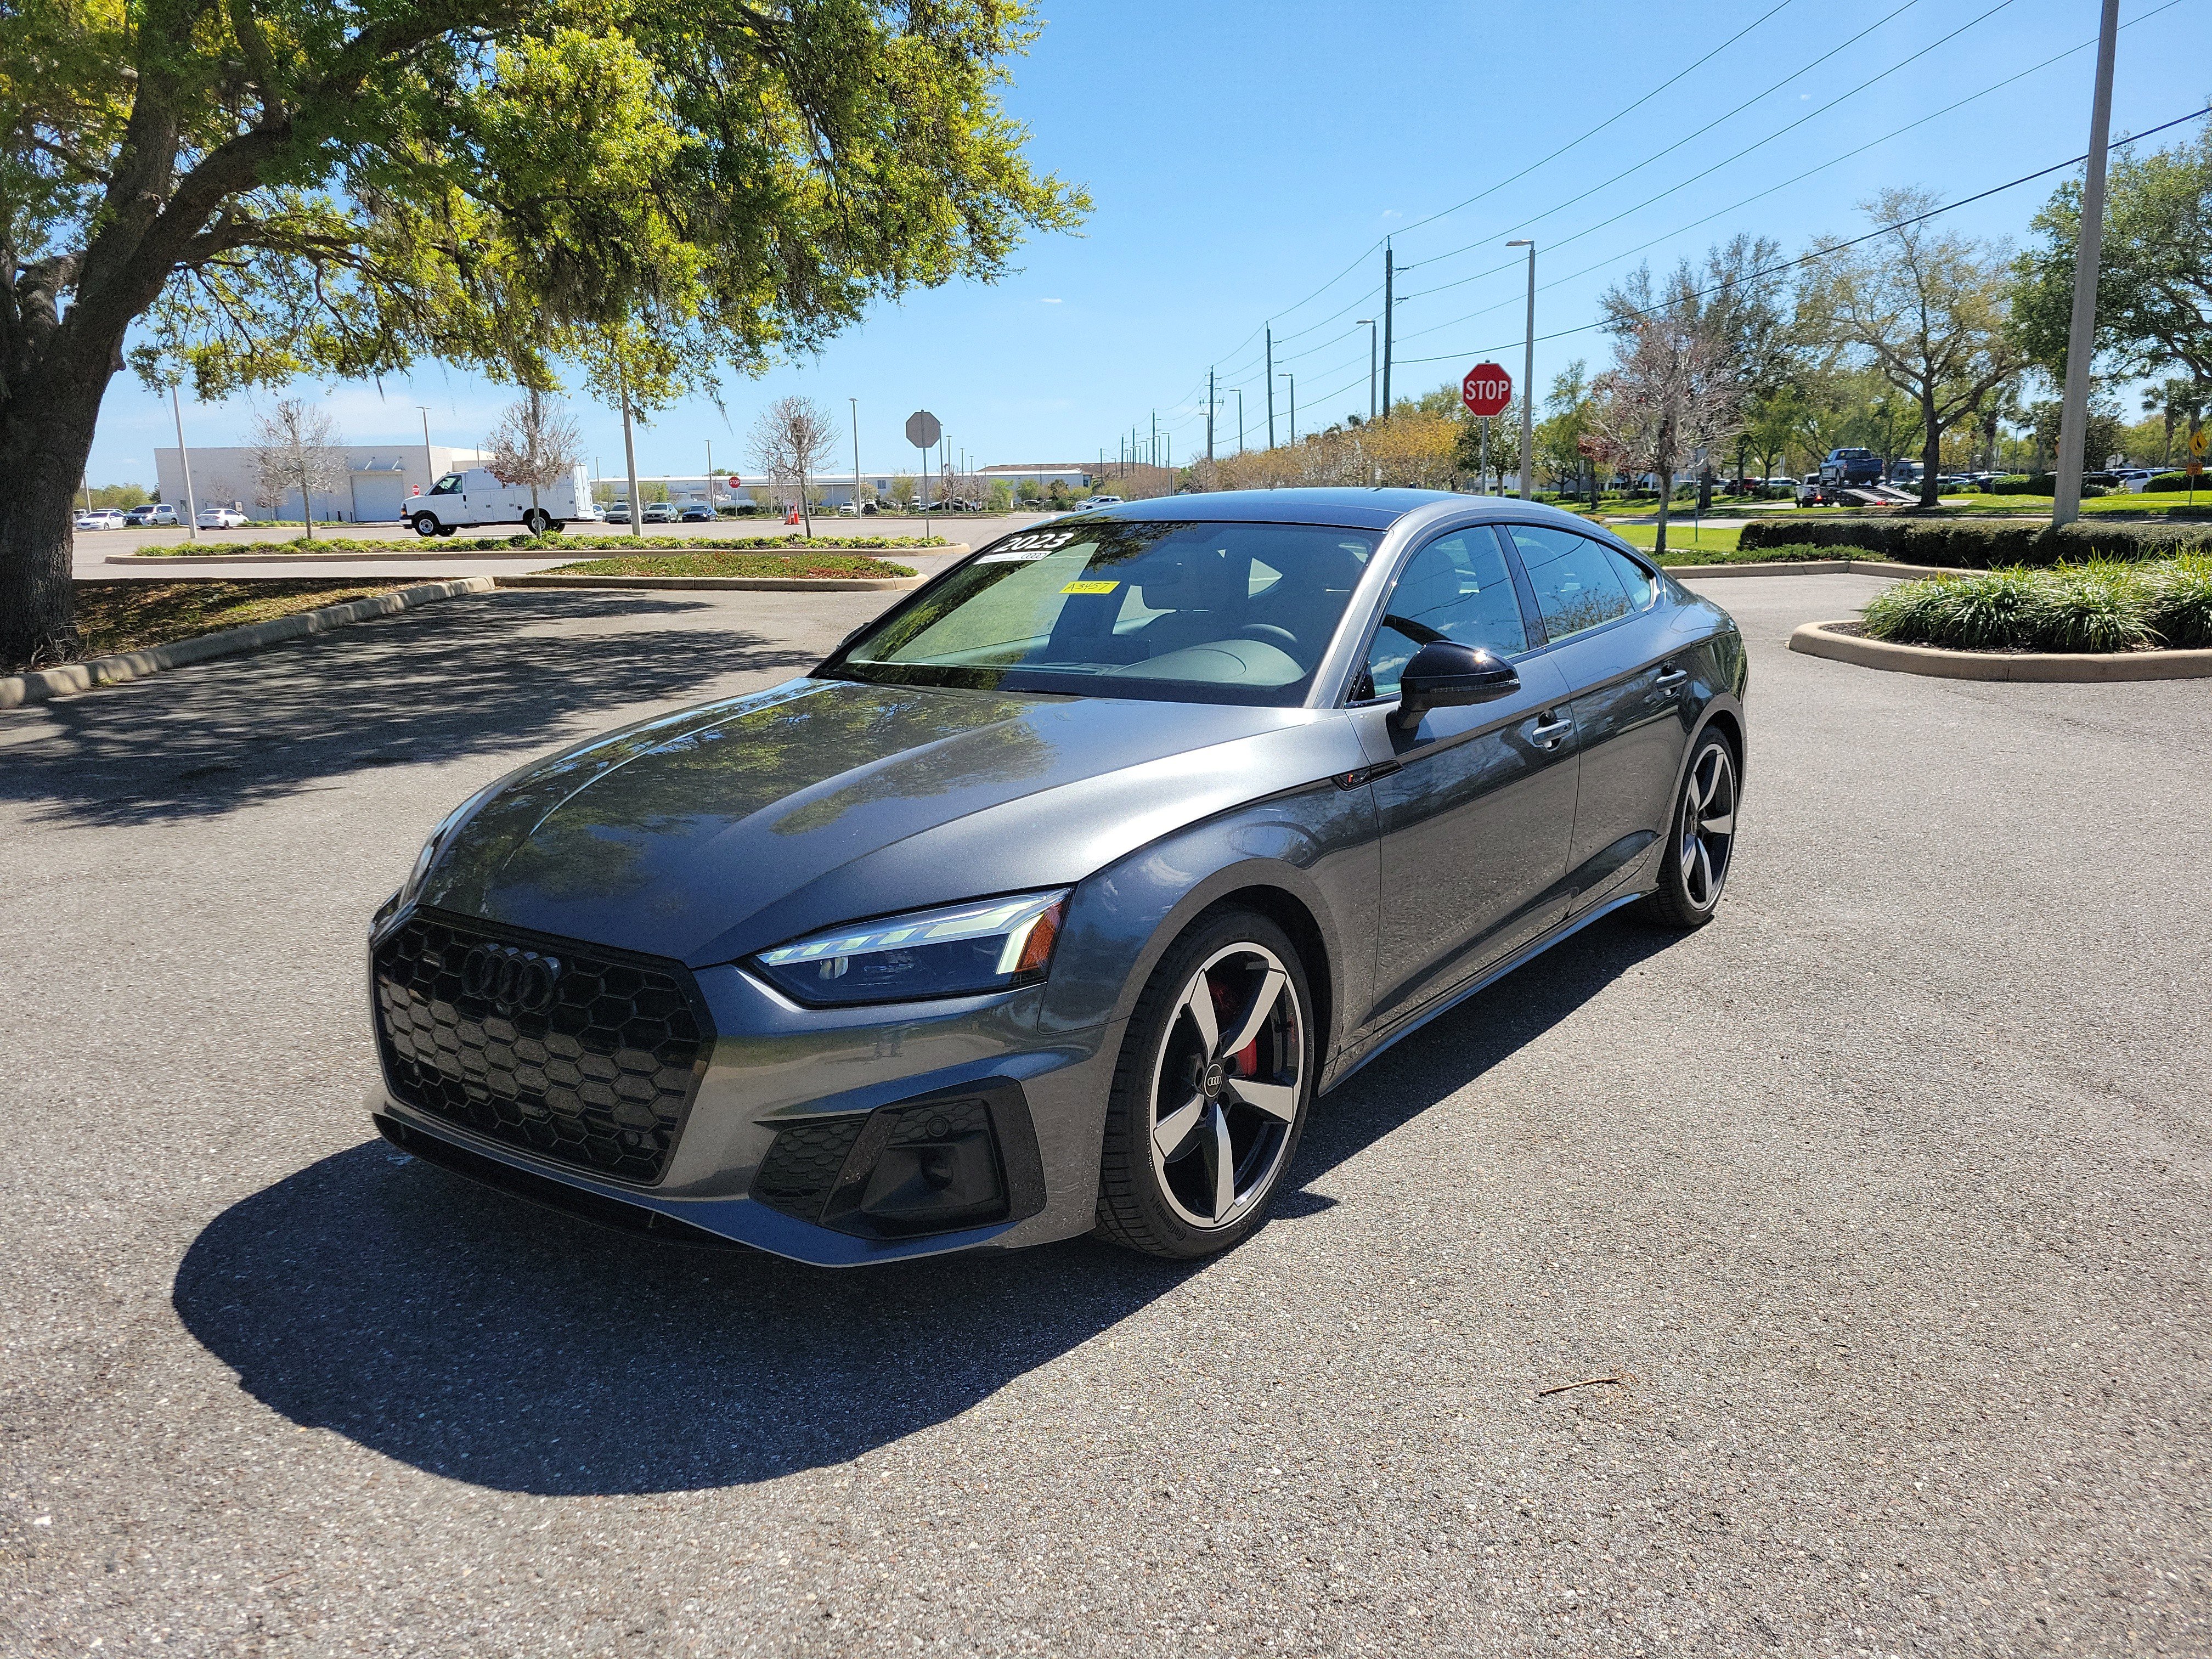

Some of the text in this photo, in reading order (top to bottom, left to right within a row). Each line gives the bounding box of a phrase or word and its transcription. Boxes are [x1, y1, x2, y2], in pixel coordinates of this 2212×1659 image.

[1465, 380, 1509, 400] STOP
[992, 533, 1074, 553] 2023
[1064, 583, 1110, 591] A3457
[1153, 1200, 1187, 1241] Continental
